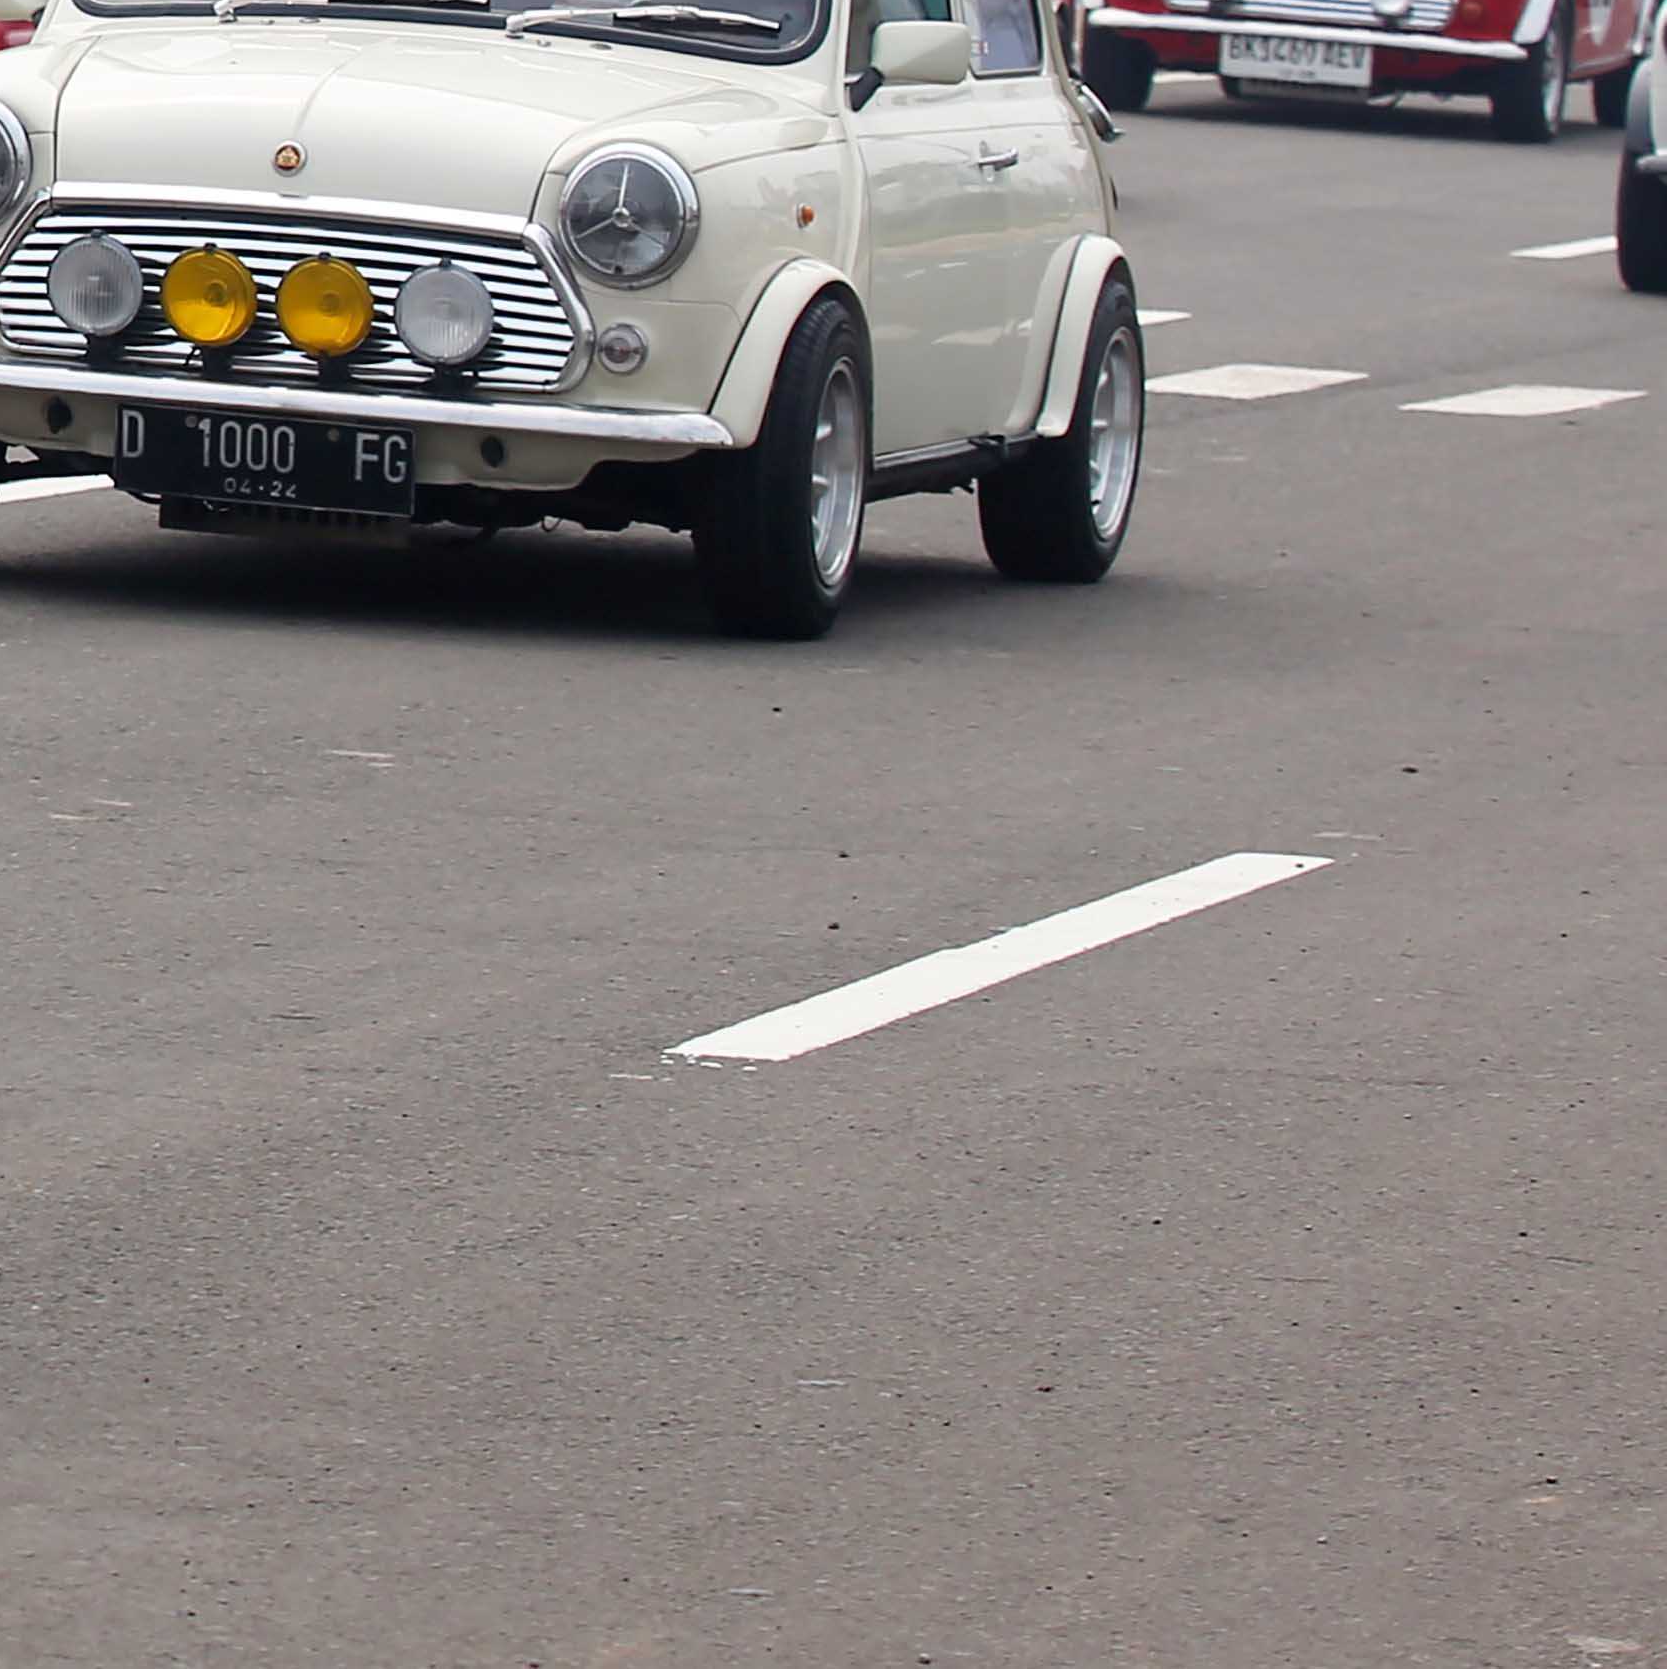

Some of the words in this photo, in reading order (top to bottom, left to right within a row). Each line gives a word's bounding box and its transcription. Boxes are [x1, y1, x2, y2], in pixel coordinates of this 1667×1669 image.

[122, 409, 144, 459] D
[197, 417, 296, 474] 1000
[354, 432, 408, 483] FG
